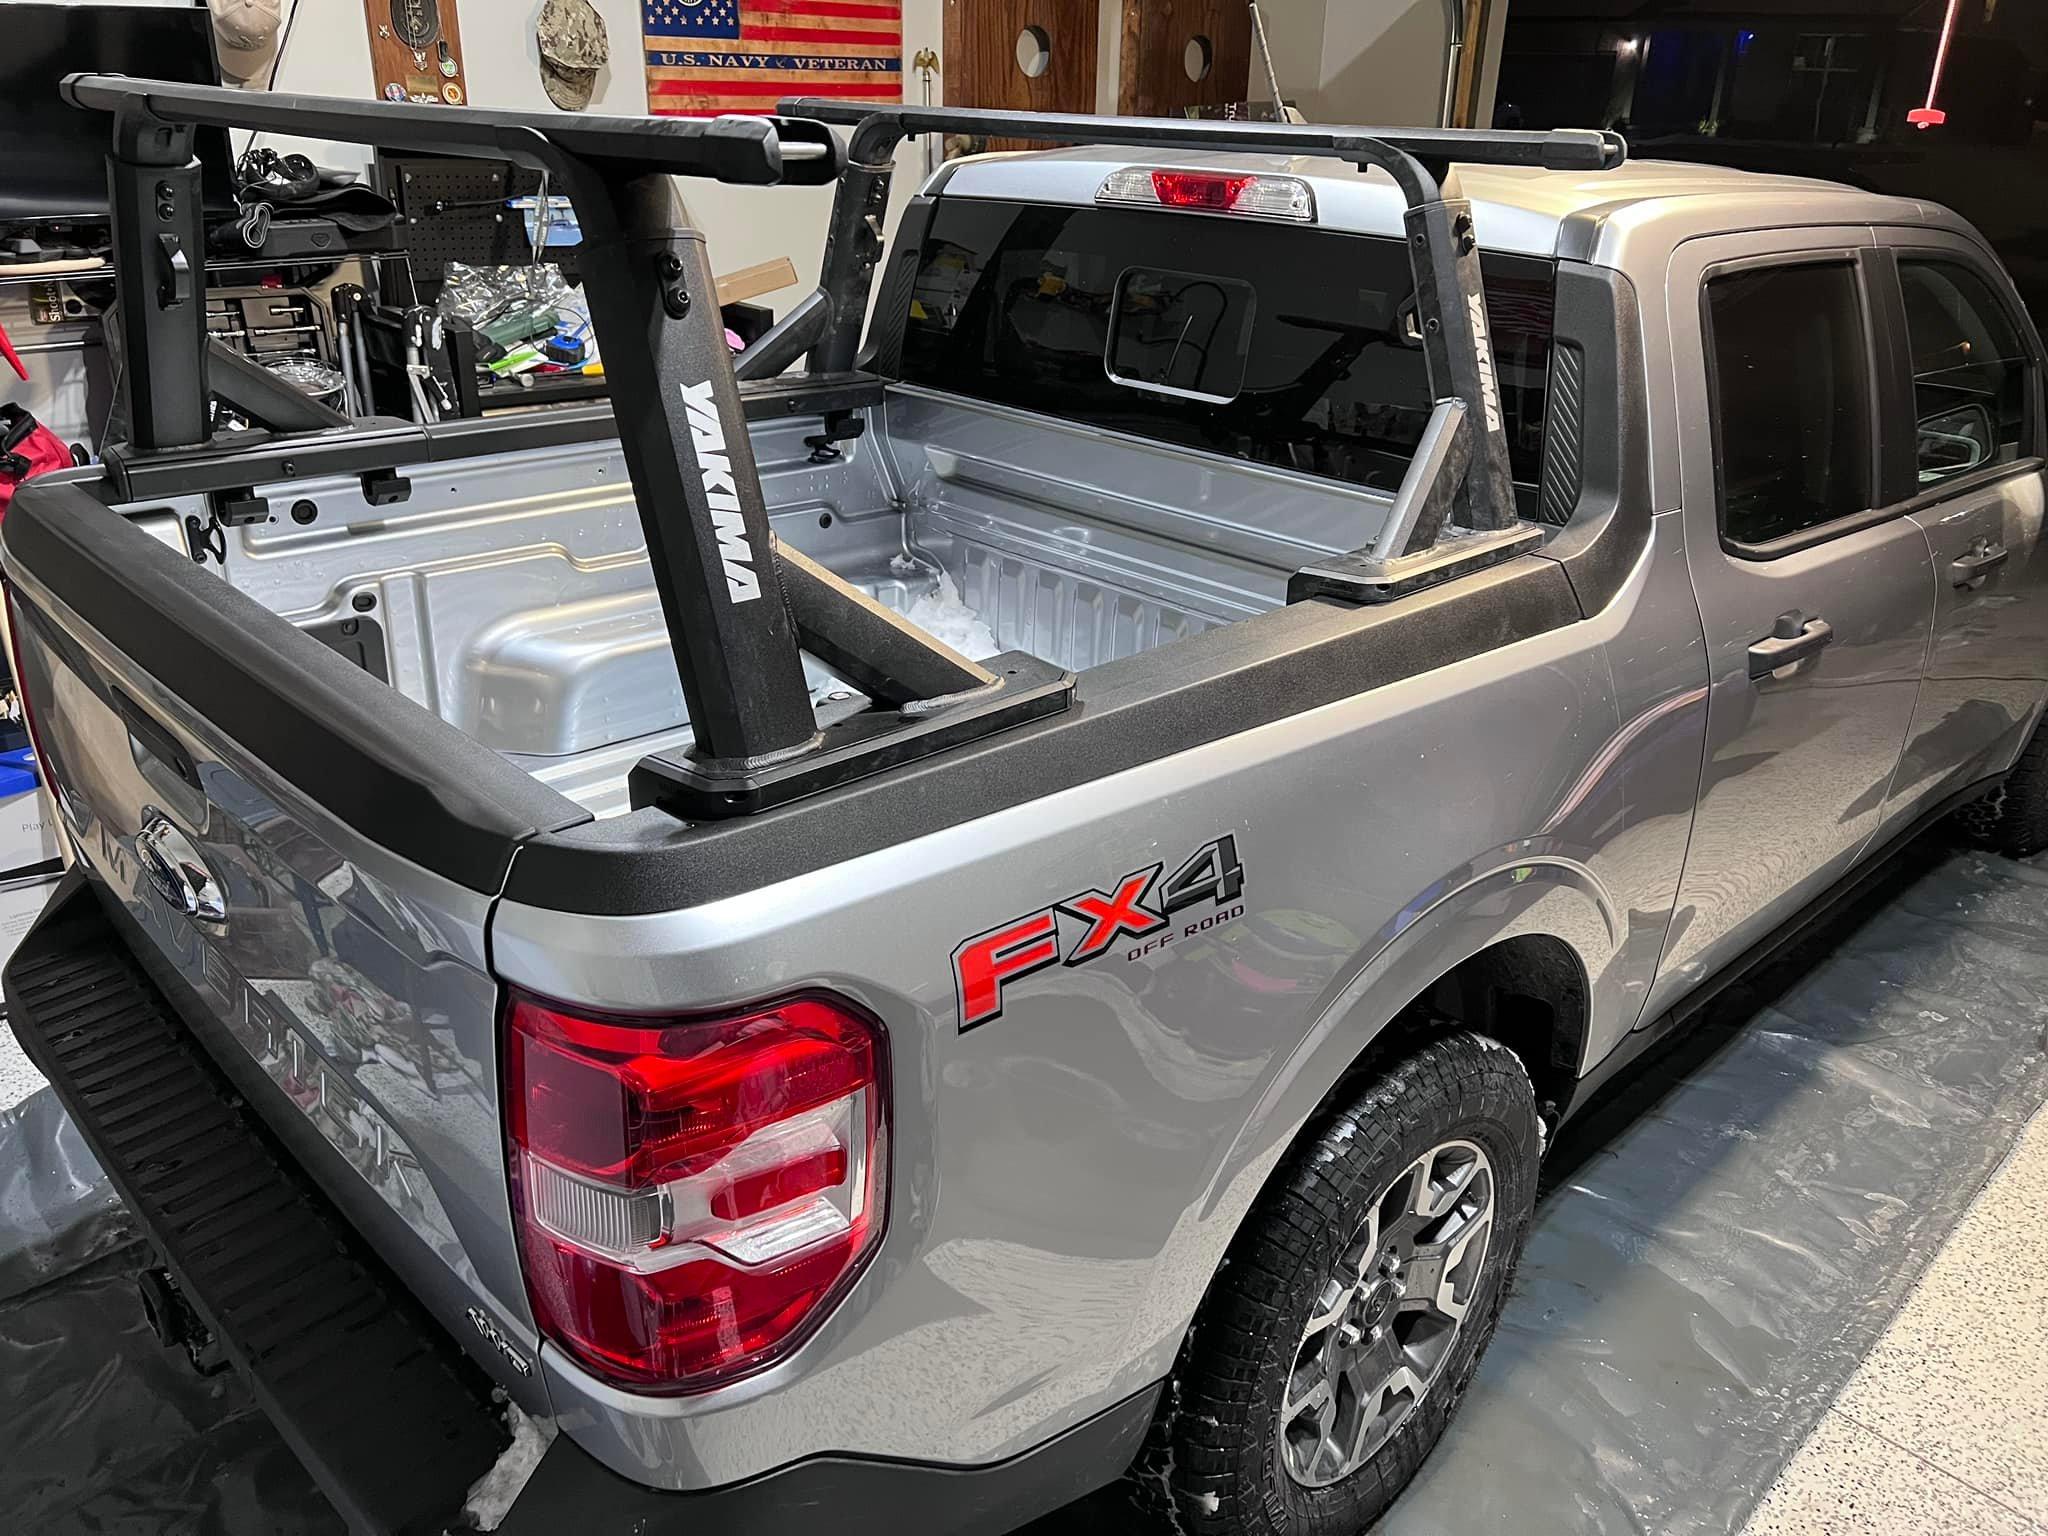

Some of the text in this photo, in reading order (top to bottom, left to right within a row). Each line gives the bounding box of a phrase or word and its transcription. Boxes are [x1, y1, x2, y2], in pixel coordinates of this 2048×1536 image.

[661, 53, 888, 70] U.S. NAVY VETERAN
[1467, 292, 1500, 433] YAKIMA
[679, 379, 762, 604] YAKIMA
[949, 831, 1245, 1037] FX4
[1128, 904, 1246, 963] OFF ROAD
